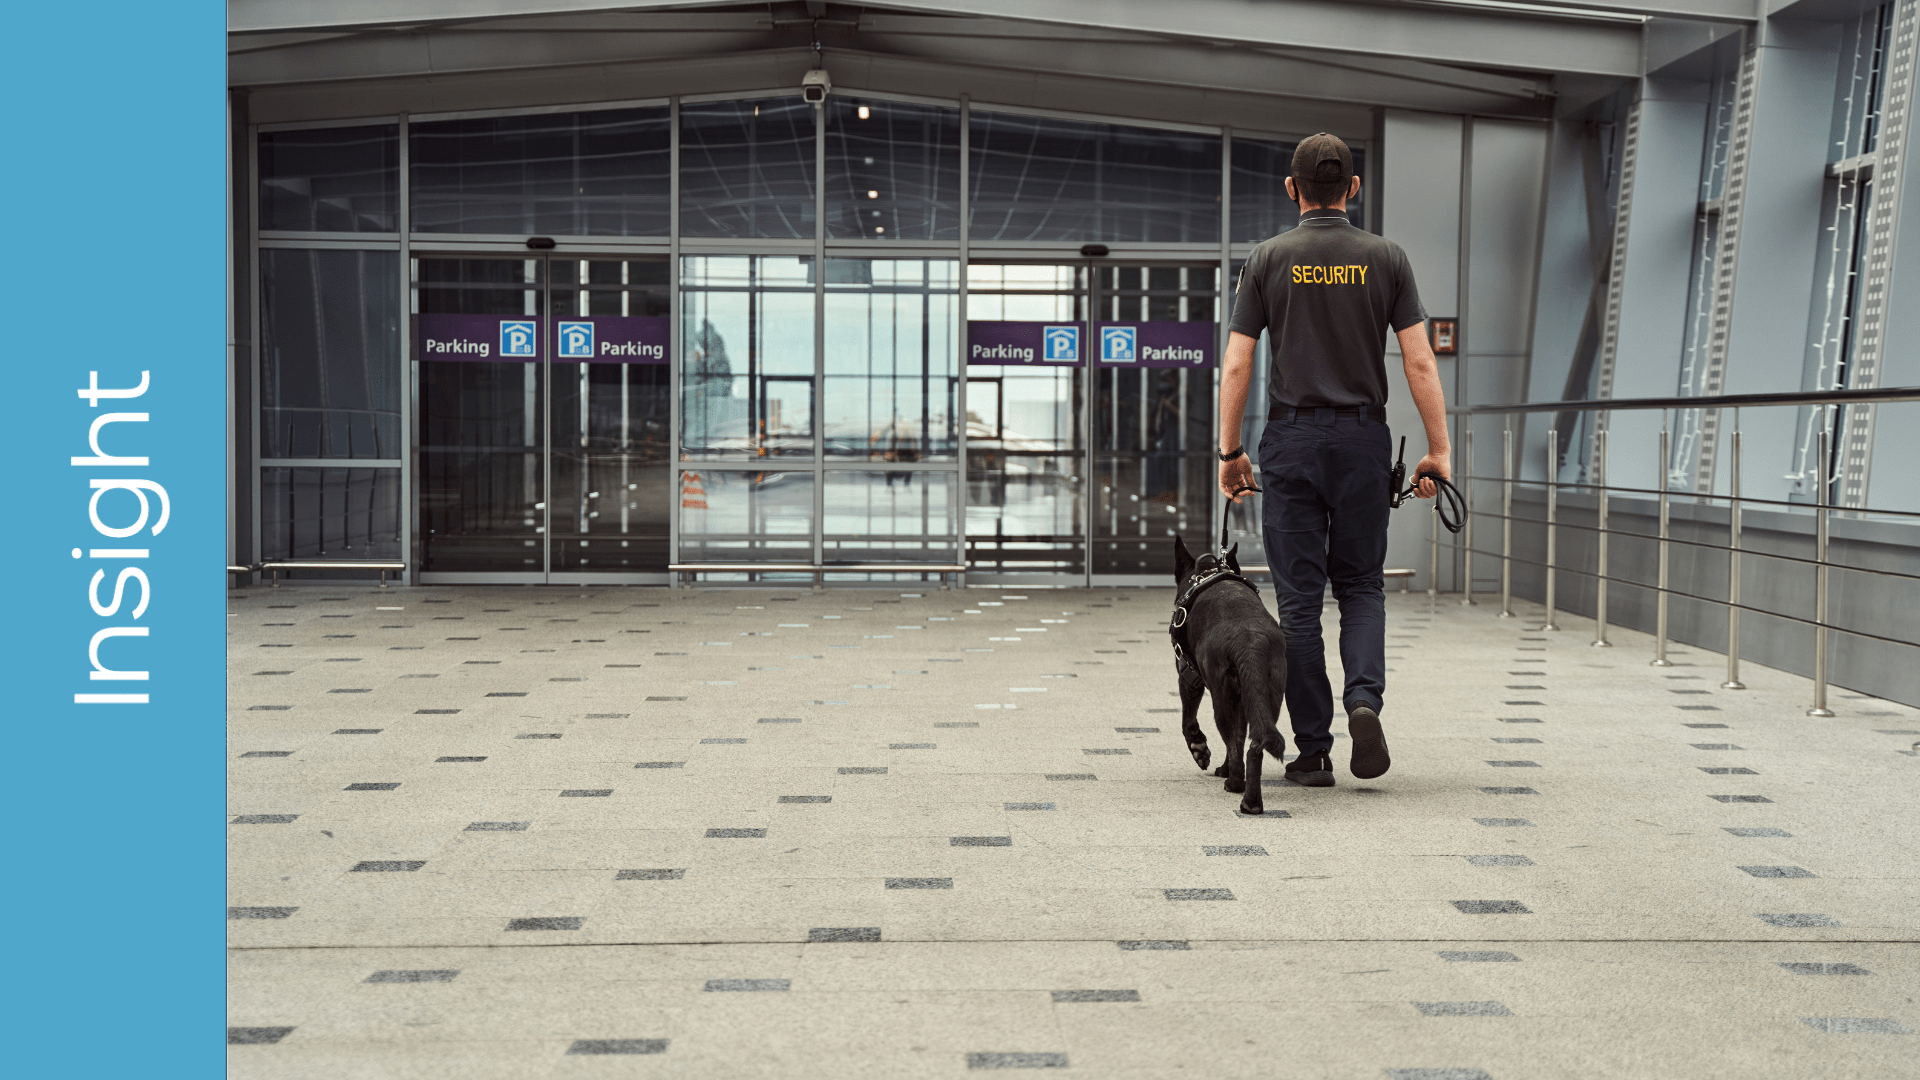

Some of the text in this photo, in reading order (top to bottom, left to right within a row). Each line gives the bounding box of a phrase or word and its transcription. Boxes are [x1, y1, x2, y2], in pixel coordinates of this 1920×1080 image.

[1292, 265, 1368, 285] SECURITY
[426, 338, 490, 357] Parking
[601, 340, 663, 359] Parking
[972, 344, 1034, 362] Parking
[1142, 345, 1204, 364] Parking
